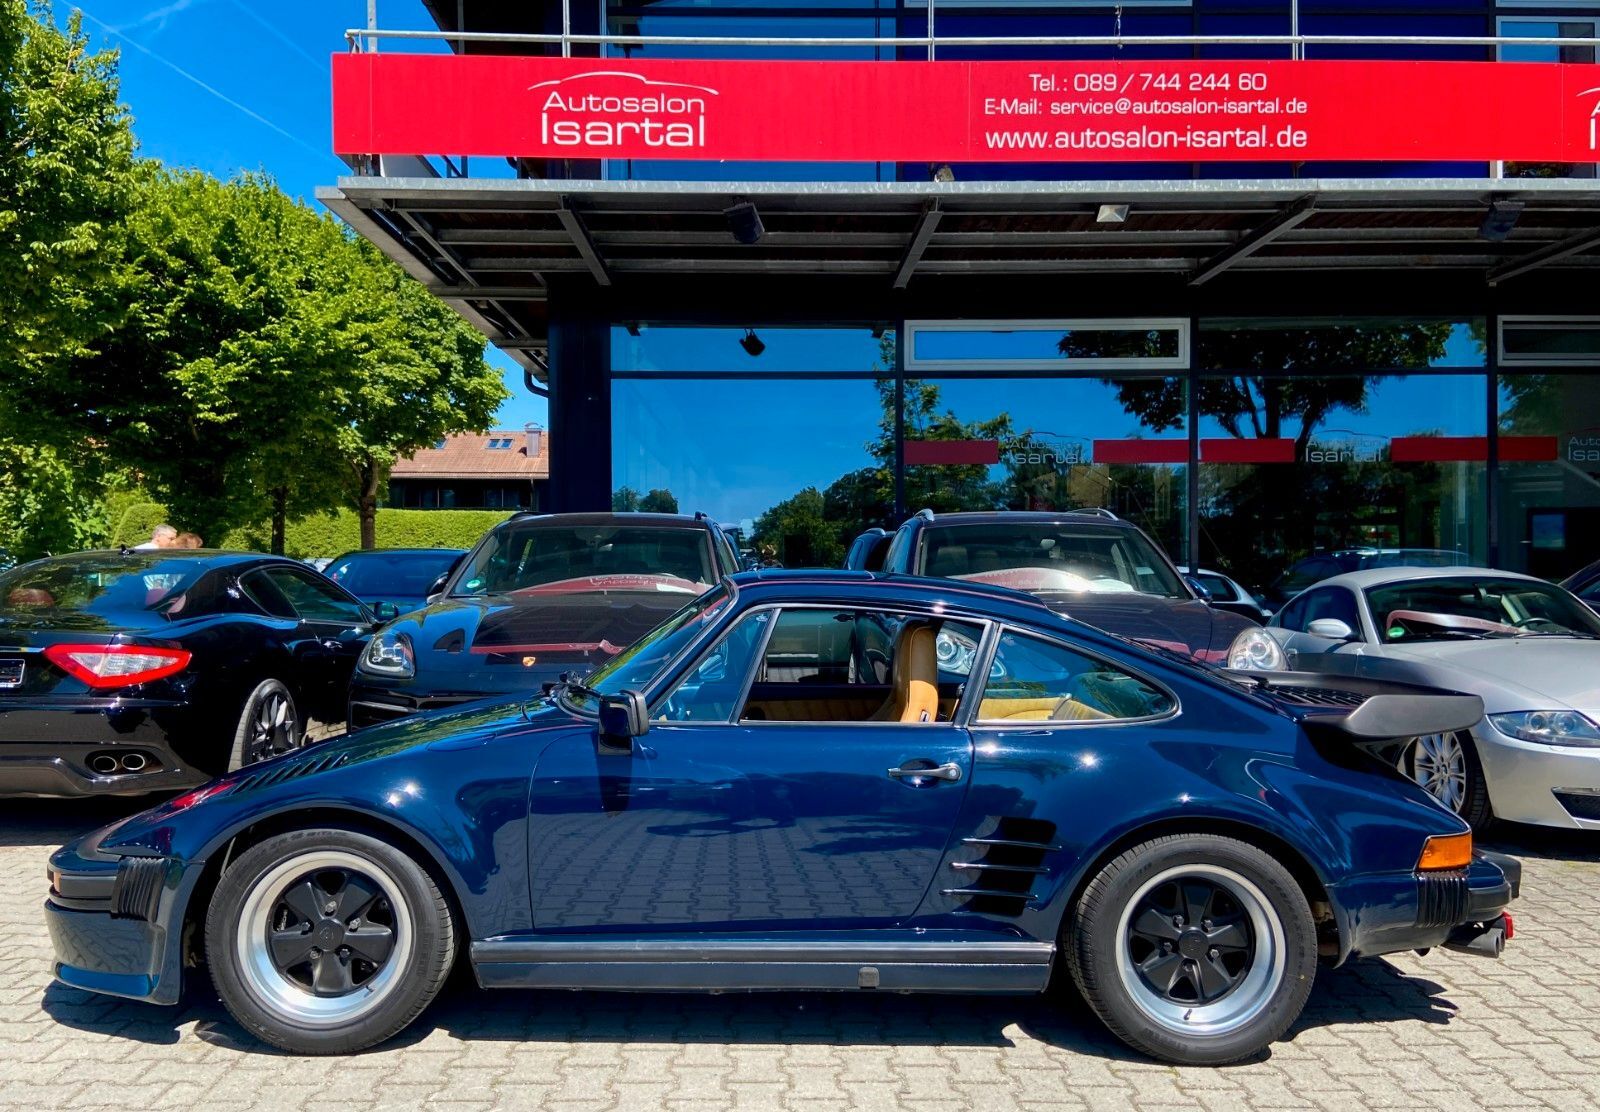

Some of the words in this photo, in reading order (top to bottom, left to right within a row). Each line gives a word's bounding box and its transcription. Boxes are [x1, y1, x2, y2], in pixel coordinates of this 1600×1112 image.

[1029, 73, 1067, 92] Tel.:
[1189, 73, 1231, 91] 244
[1238, 72, 1267, 91] 60
[541, 91, 705, 114] Autosalon
[984, 98, 1042, 115] E-Mail:
[1050, 97, 1308, 115] service@autosalon-isartal.de
[541, 114, 705, 147] Isartal
[985, 125, 1307, 149] www.autosalon-isartal.de
[1305, 447, 1382, 463] Isartal
